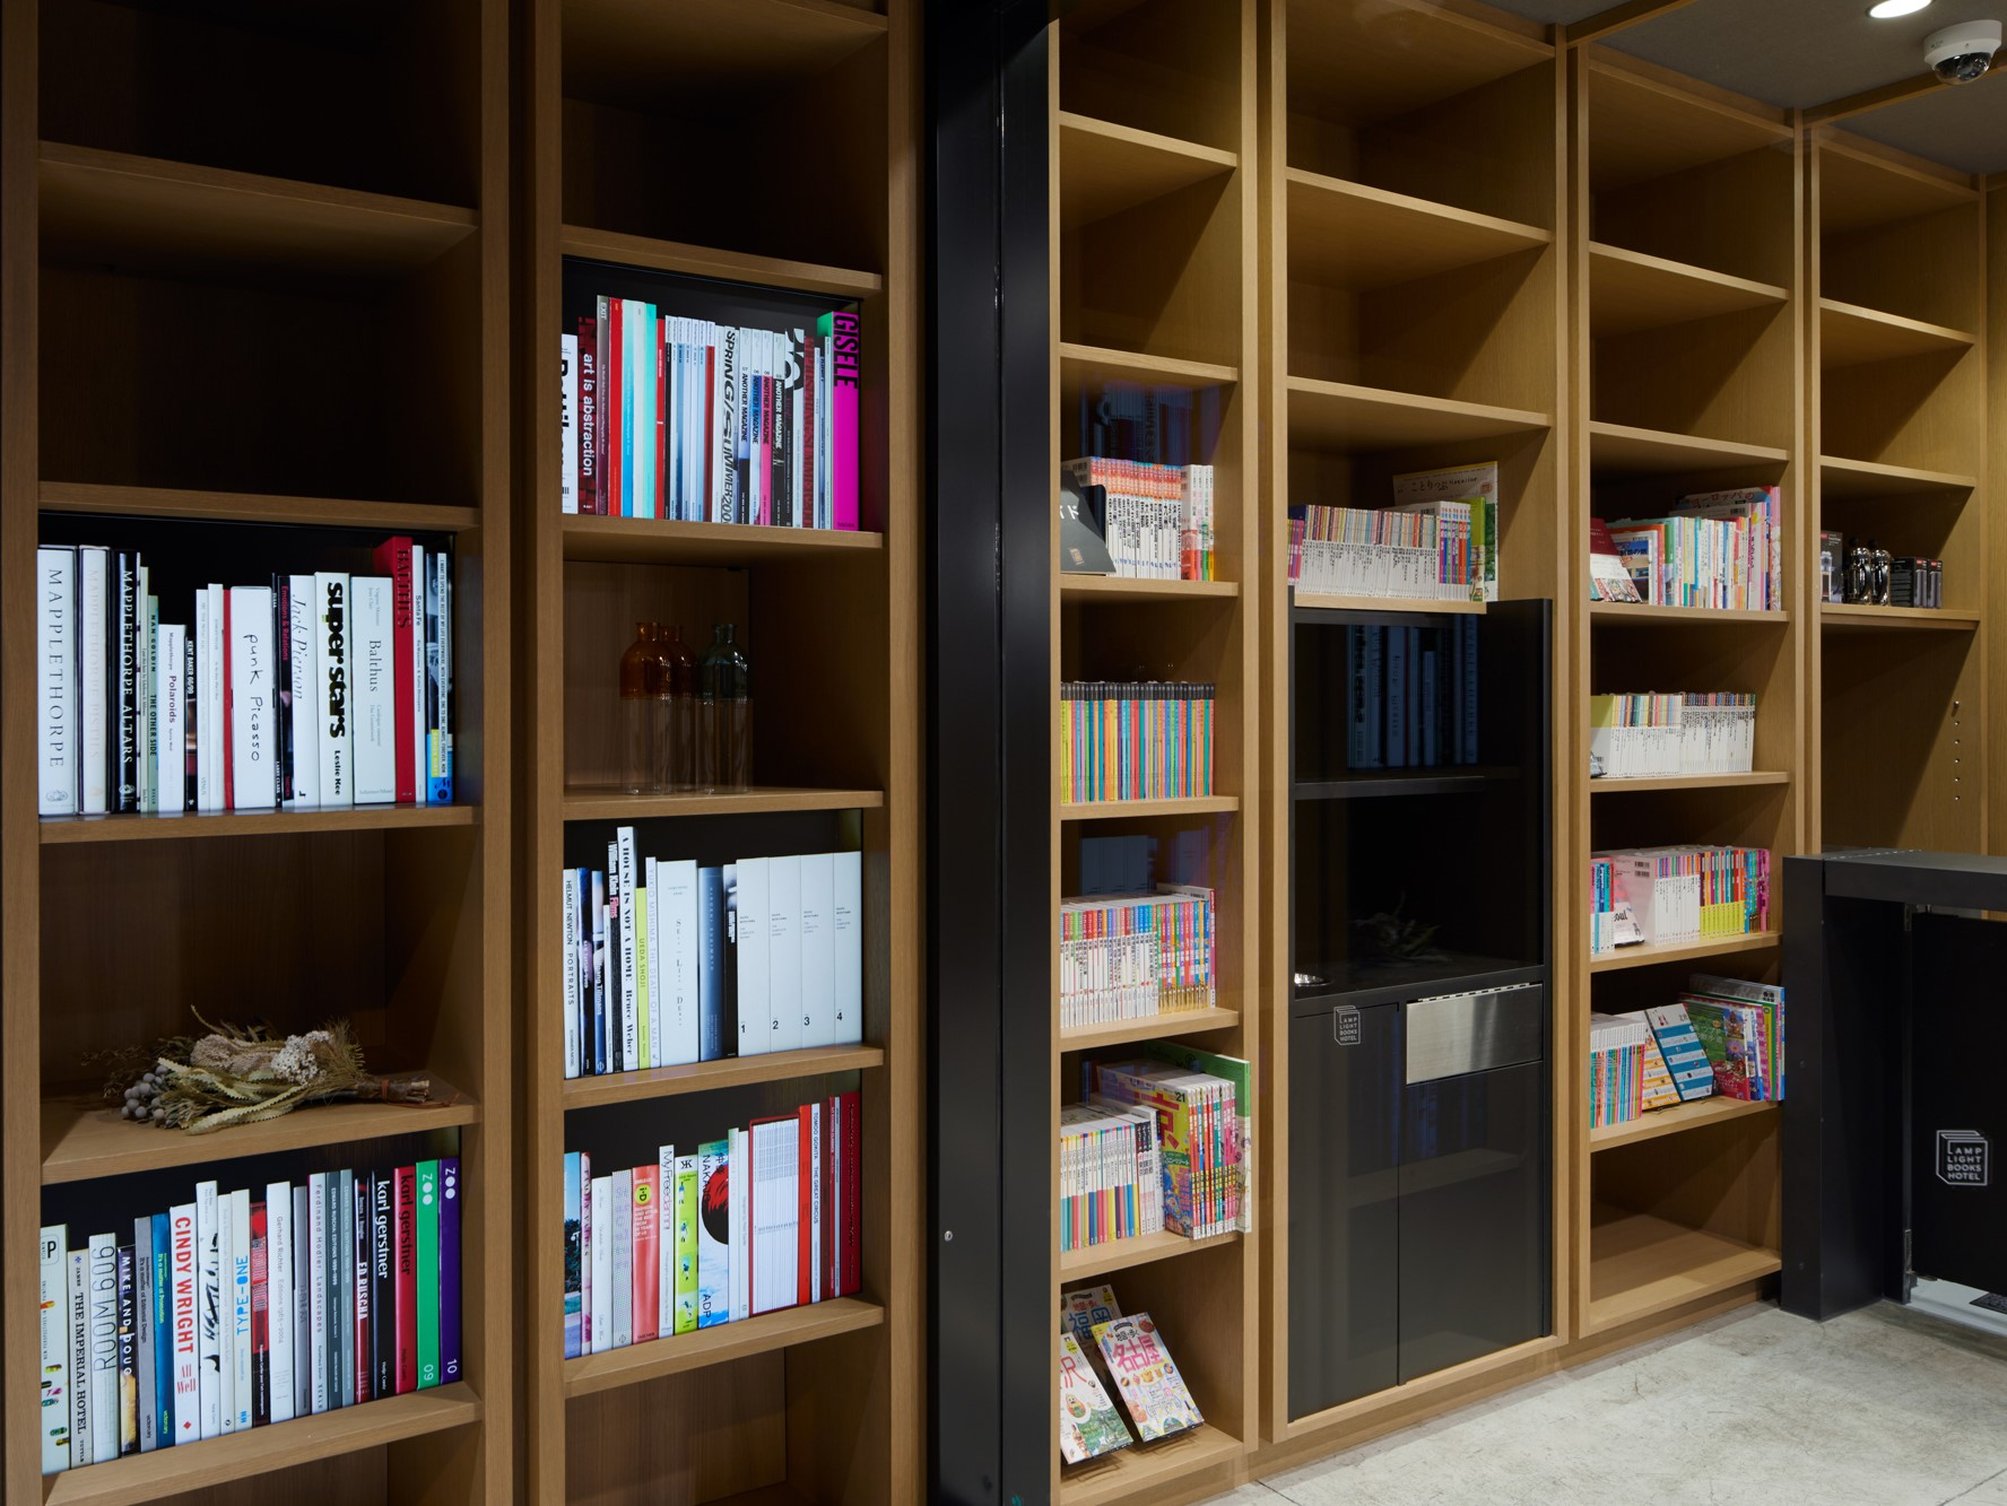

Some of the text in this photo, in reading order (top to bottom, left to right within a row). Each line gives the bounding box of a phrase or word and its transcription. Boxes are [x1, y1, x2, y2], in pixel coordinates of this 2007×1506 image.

[834, 314, 859, 389] GISELE
[583, 353, 595, 476] art is abstraction
[775, 380, 783, 449] ANOTHER MAGAZINE
[281, 585, 290, 618] Emotions
[397, 549, 412, 629] BALTHUS
[281, 628, 290, 661] Relations
[291, 594, 308, 700] Jack Pierson
[415, 617, 422, 627] Fe
[48, 568, 64, 768] MAPPLETHORPE
[122, 570, 134, 764] MAPPLETHORPE ALTARS
[186, 640, 195, 676] KENT BAKER
[368, 639, 383, 693] Balthus
[168, 674, 178, 724] Polaroids
[244, 635, 264, 762] punk Picasso
[150, 694, 158, 757] THE OTHER SIDE
[334, 750, 342, 797] Leslie Kee
[608, 875, 619, 896] Klein
[623, 848, 631, 887] HOUSE
[565, 880, 574, 946] HELMUT NEWTON
[608, 897, 619, 919] Films
[624, 909, 632, 932] NOT
[567, 953, 575, 1006] PORTRAITS
[625, 948, 633, 981] HOME
[638, 938, 646, 988] UEDA SHOJI
[626, 990, 635, 1055] Bruce Weber
[772, 1020, 779, 1030] 2
[803, 1016, 810, 1026] 3
[836, 1012, 843, 1021] 4
[1947, 1155, 1981, 1163] LIGHT
[1947, 1164, 1982, 1172] BOOKS
[1947, 1172, 1981, 1181] HOTEL
[47, 1240, 58, 1259] P
[276, 1216, 285, 1273] Gerhard Richter
[374, 1180, 391, 1279] karl gerstner
[398, 1175, 414, 1275] karl gerstner
[121, 1256, 131, 1294] MIKE
[316, 1184, 324, 1333] Ferdinand Landscapes
[92, 1245, 117, 1372] ROOM 606
[174, 1216, 194, 1355] CINDY WRIGHT
[235, 1257, 249, 1336] TYPE-ONE
[358, 1261, 368, 1320] ED RUSCHA
[702, 1293, 712, 1318] ADP
[122, 1299, 132, 1328] AND
[75, 1292, 87, 1435] THE IMPERIAL HOTEL
[423, 1363, 434, 1381] 09
[447, 1358, 458, 1374] 10
[1112, 1334, 1163, 1374] 名古屋
